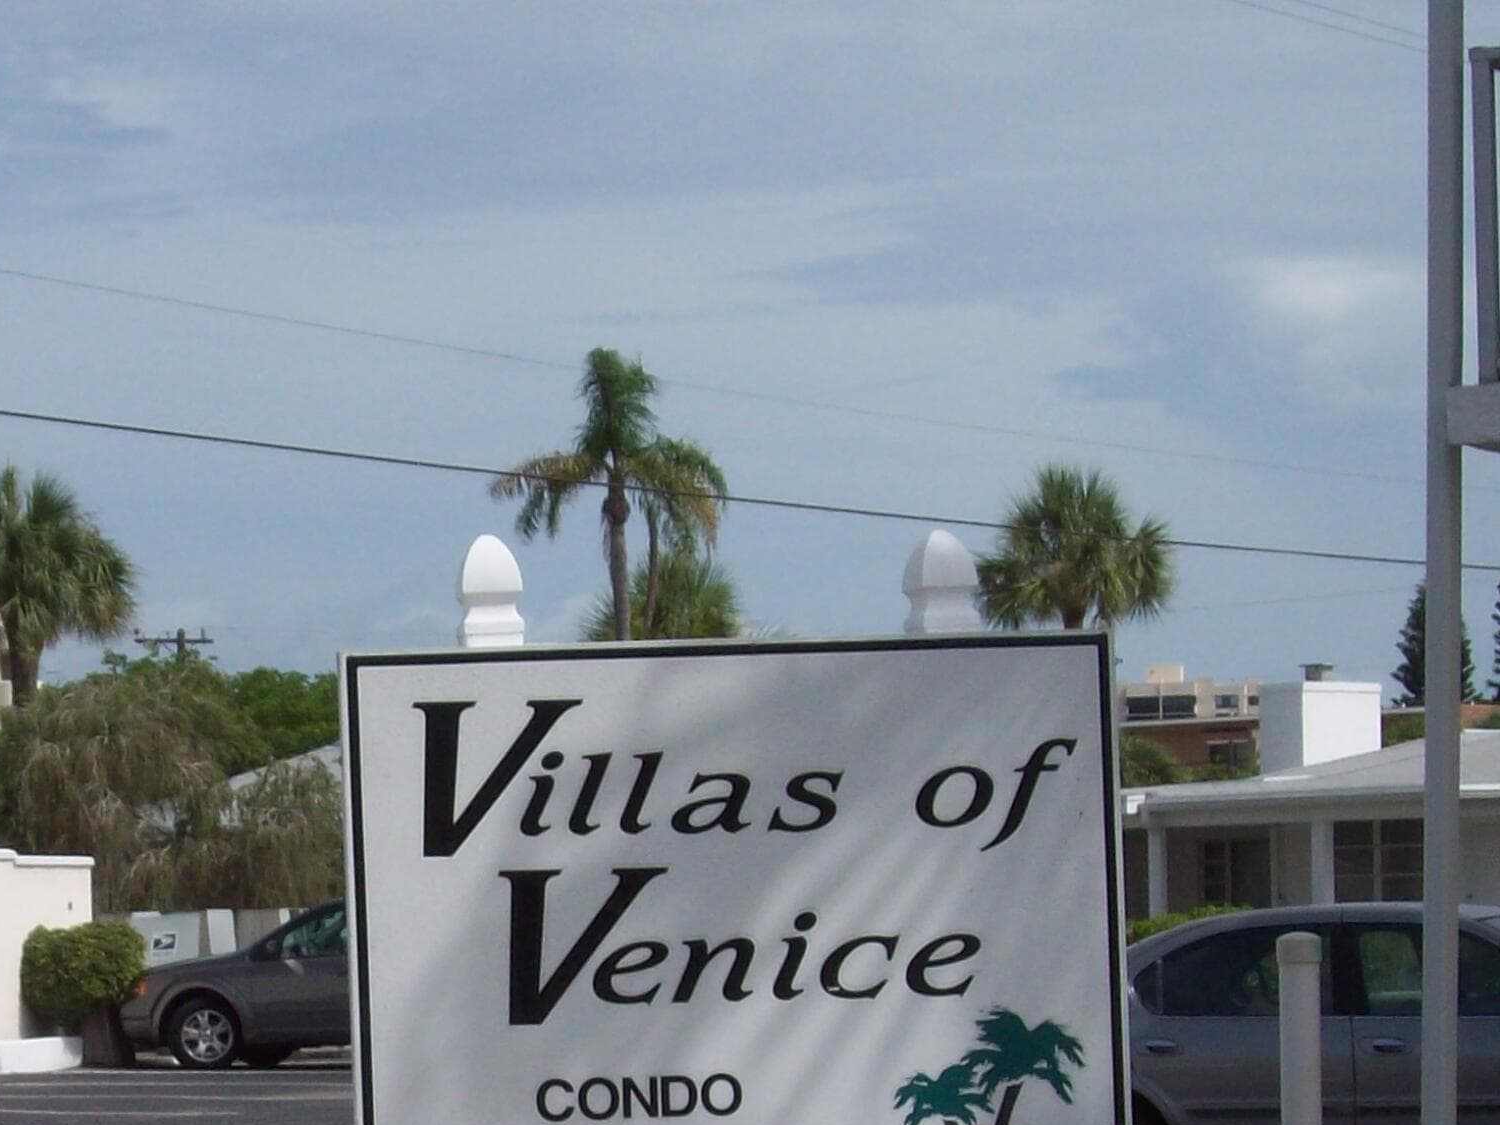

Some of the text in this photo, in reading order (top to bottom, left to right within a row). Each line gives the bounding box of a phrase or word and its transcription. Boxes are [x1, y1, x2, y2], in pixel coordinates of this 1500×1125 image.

[412, 698, 1078, 858] Villas of
[498, 866, 982, 1027] Venice
[536, 1072, 743, 1122] CONDO
